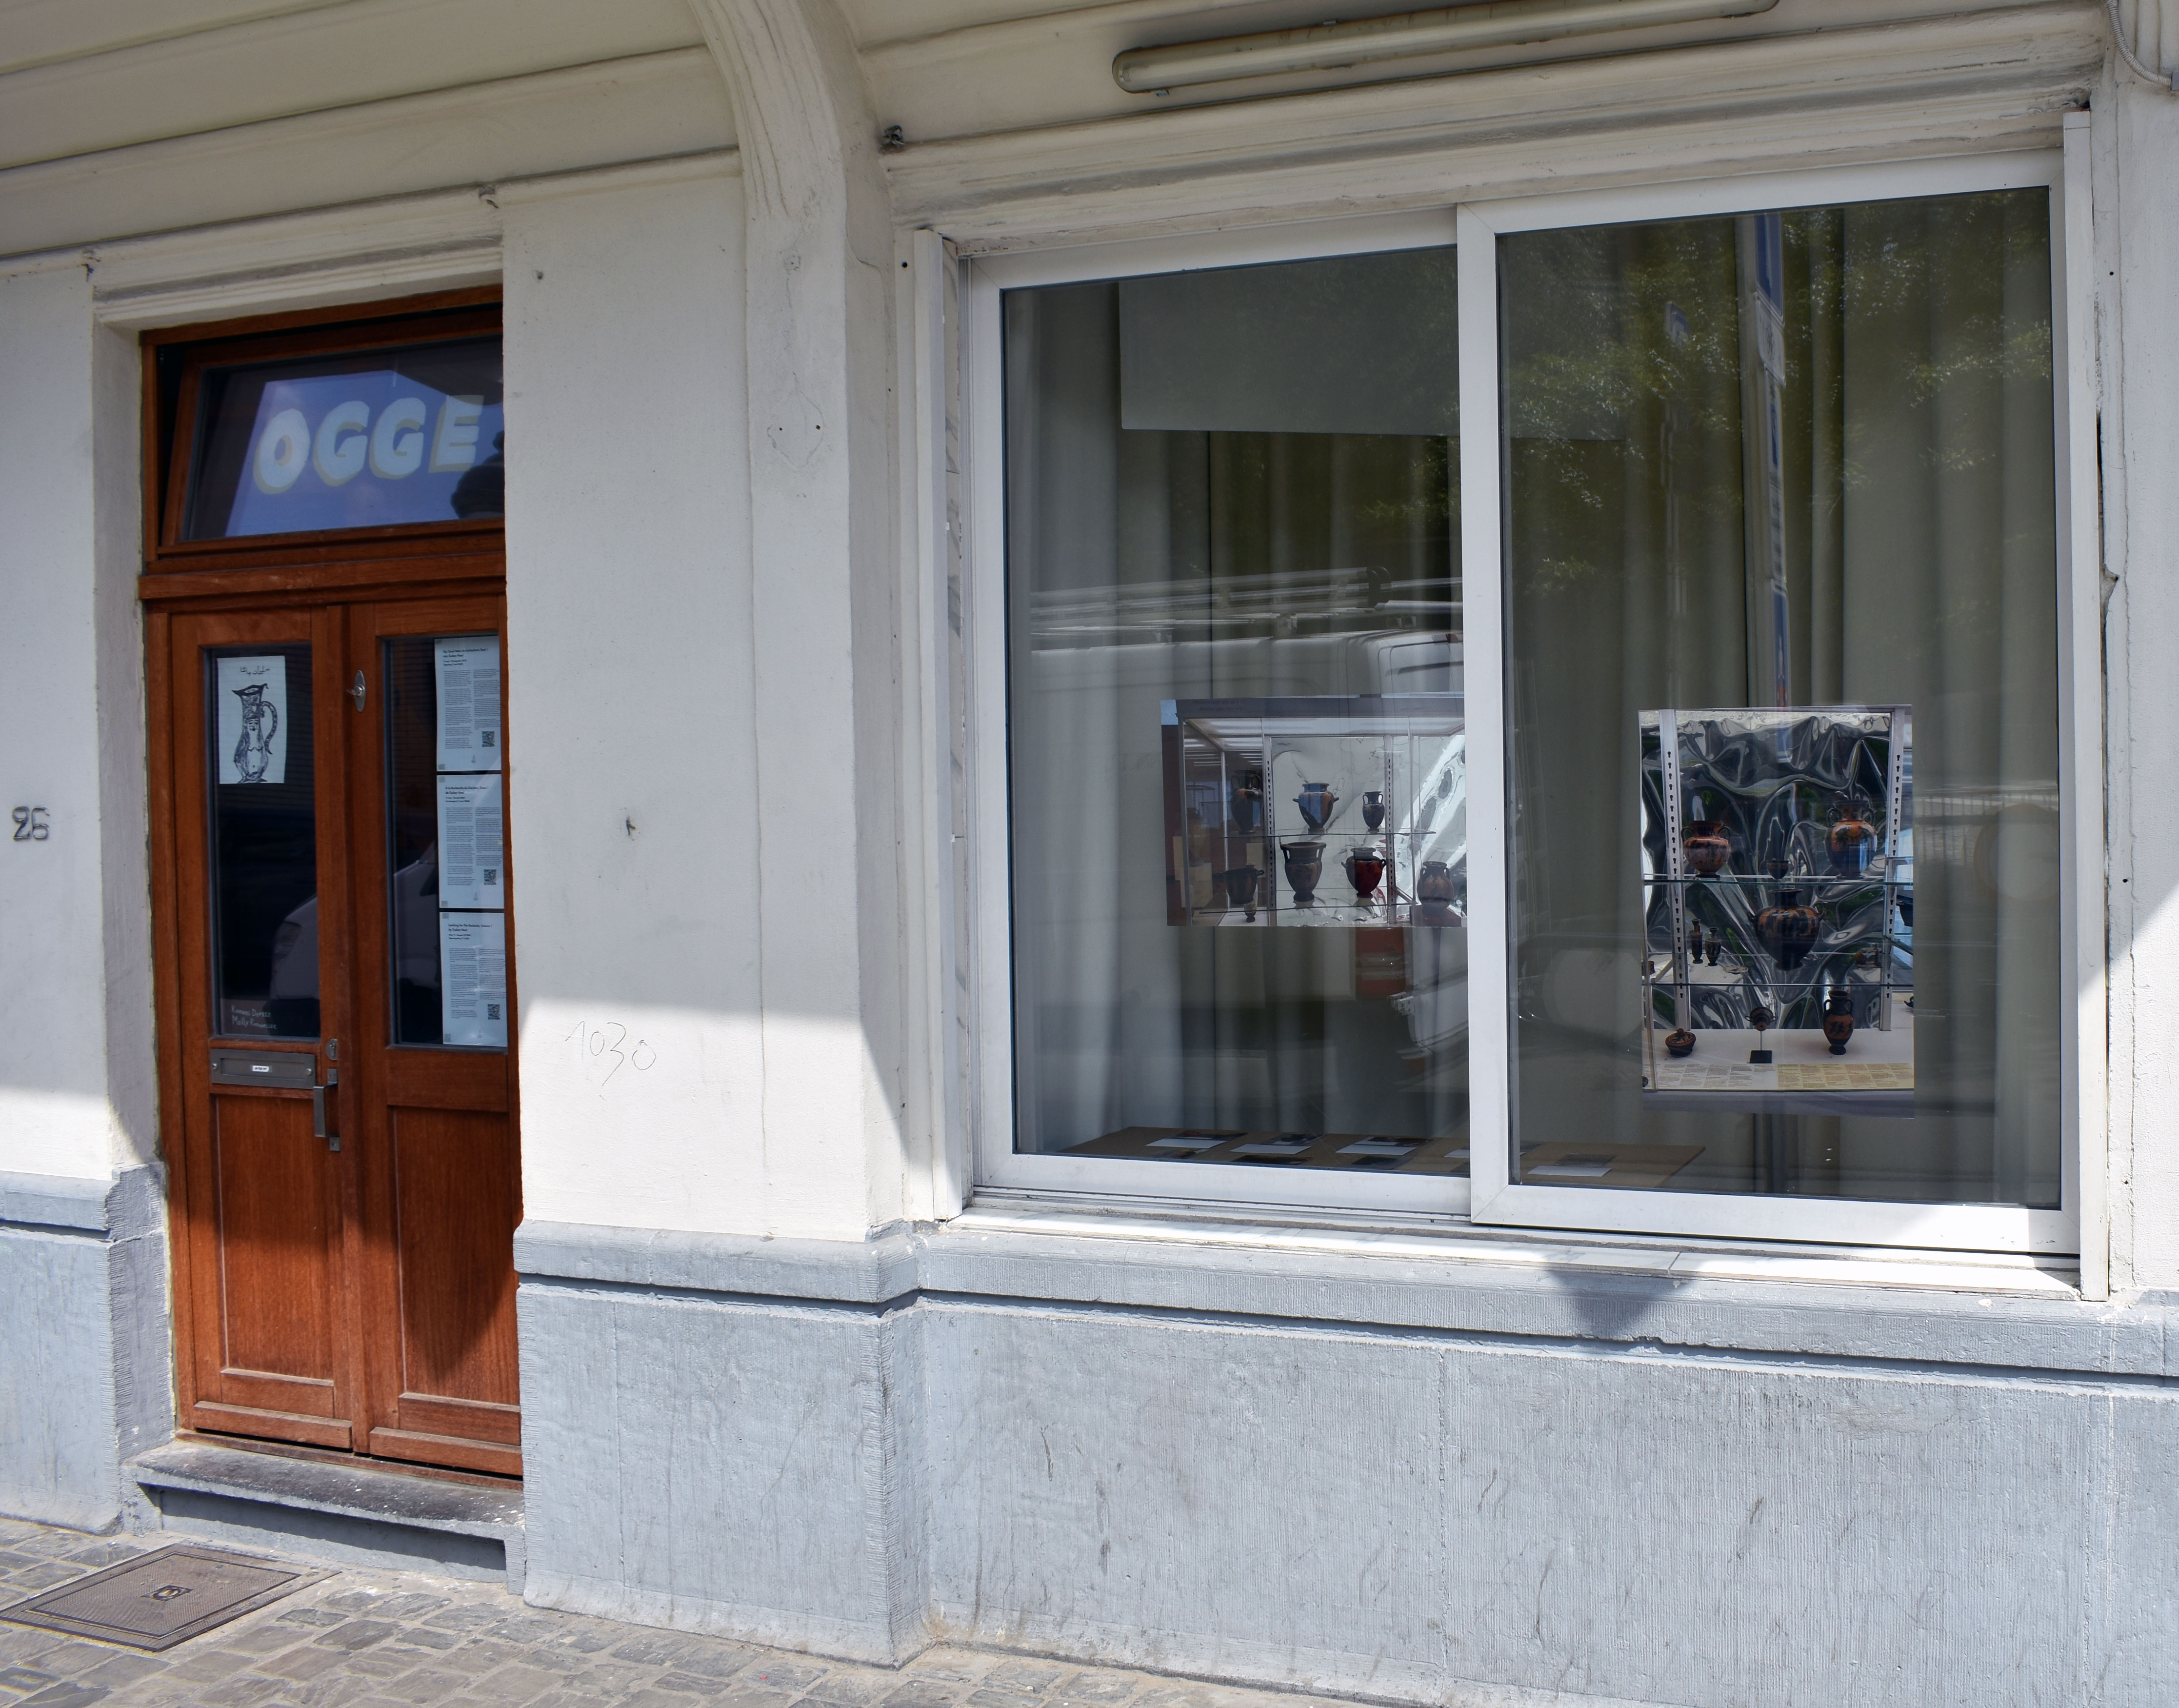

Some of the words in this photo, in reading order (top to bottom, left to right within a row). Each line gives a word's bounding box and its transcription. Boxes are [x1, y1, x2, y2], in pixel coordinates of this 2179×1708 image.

[253, 394, 484, 495] OGGE
[12, 806, 49, 841] 26
[565, 1021, 657, 1086] 1030
